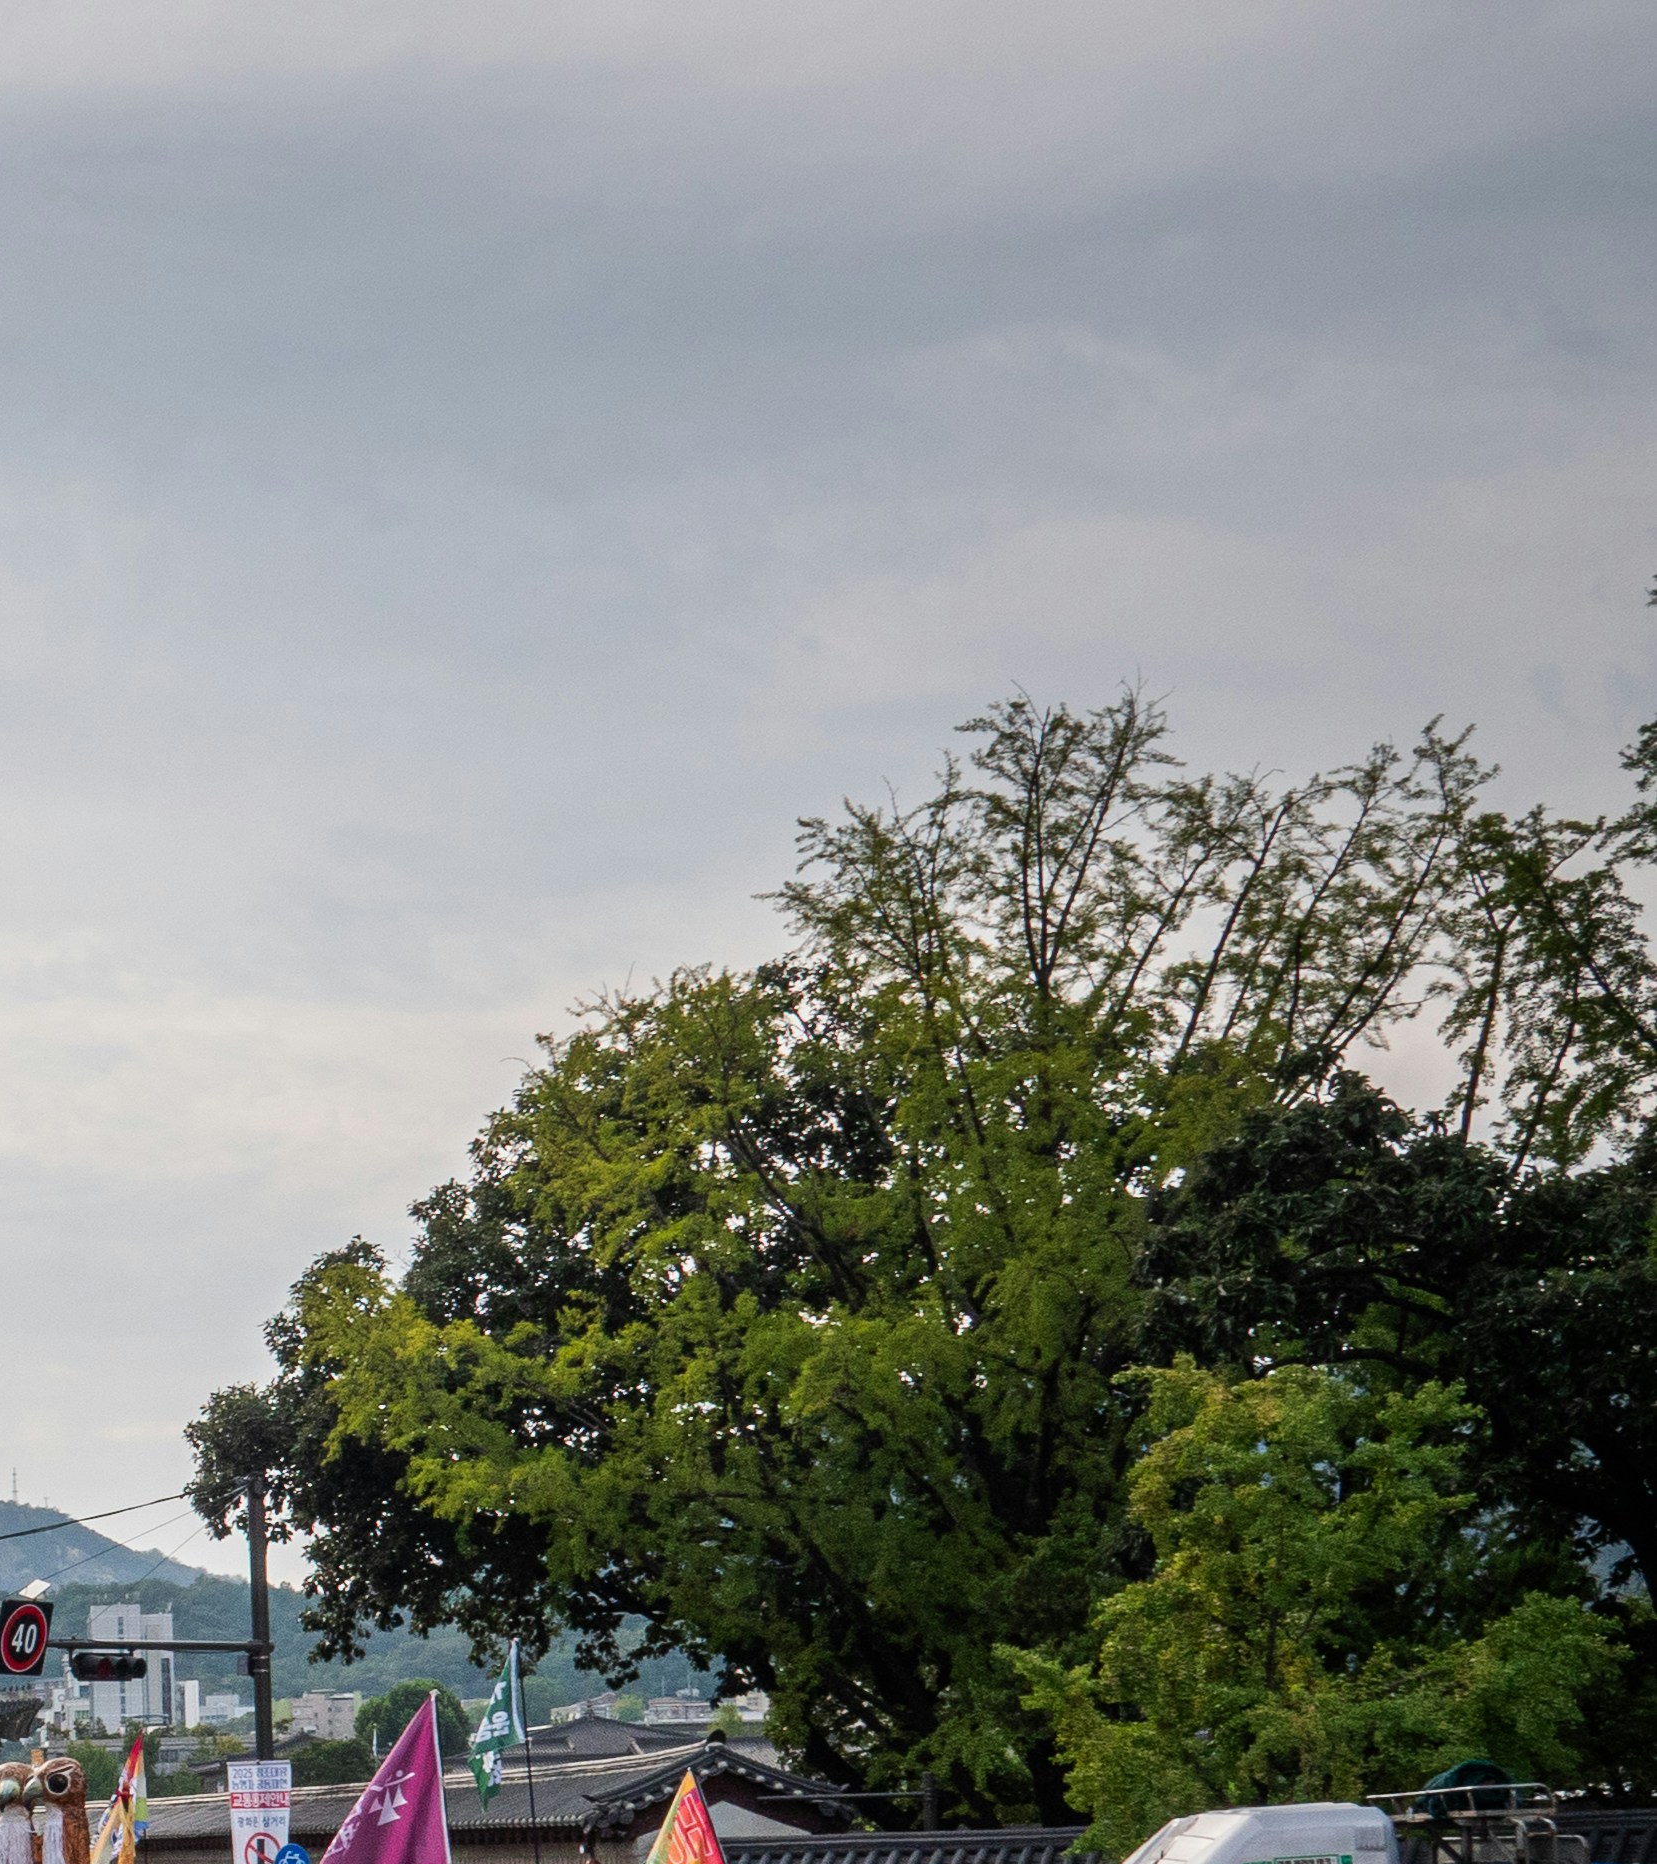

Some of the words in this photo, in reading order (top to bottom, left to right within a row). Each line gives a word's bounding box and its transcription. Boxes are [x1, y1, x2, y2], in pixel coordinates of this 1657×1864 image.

[11, 1623, 38, 1654] 40
[232, 1768, 253, 1778] 2025
[232, 1792, 290, 1808] 교통통제안내
